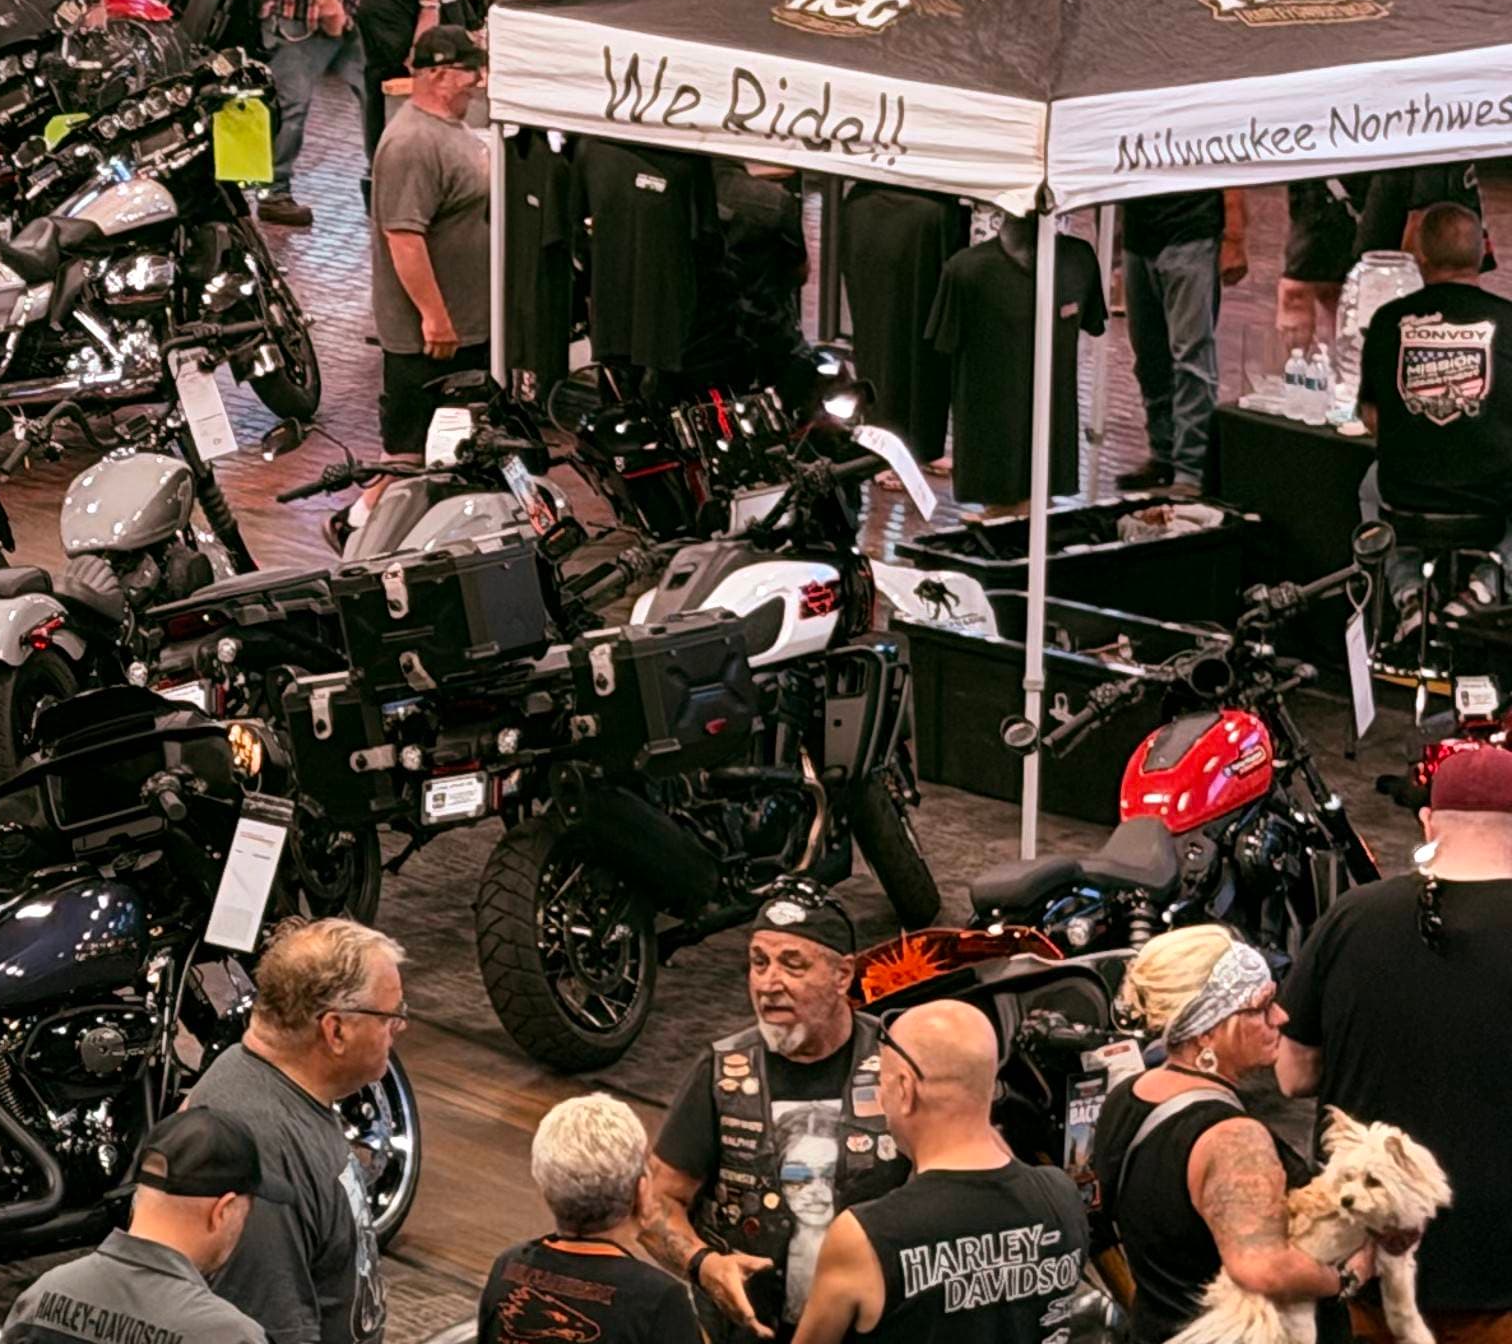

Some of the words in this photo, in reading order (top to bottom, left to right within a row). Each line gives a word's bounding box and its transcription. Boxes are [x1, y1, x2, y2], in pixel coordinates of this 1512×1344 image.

[603, 45, 701, 129] We
[1113, 117, 1317, 174] Milwaukee
[1405, 329, 1487, 340] CONVOY
[899, 1224, 1061, 1299] HARLEY-
